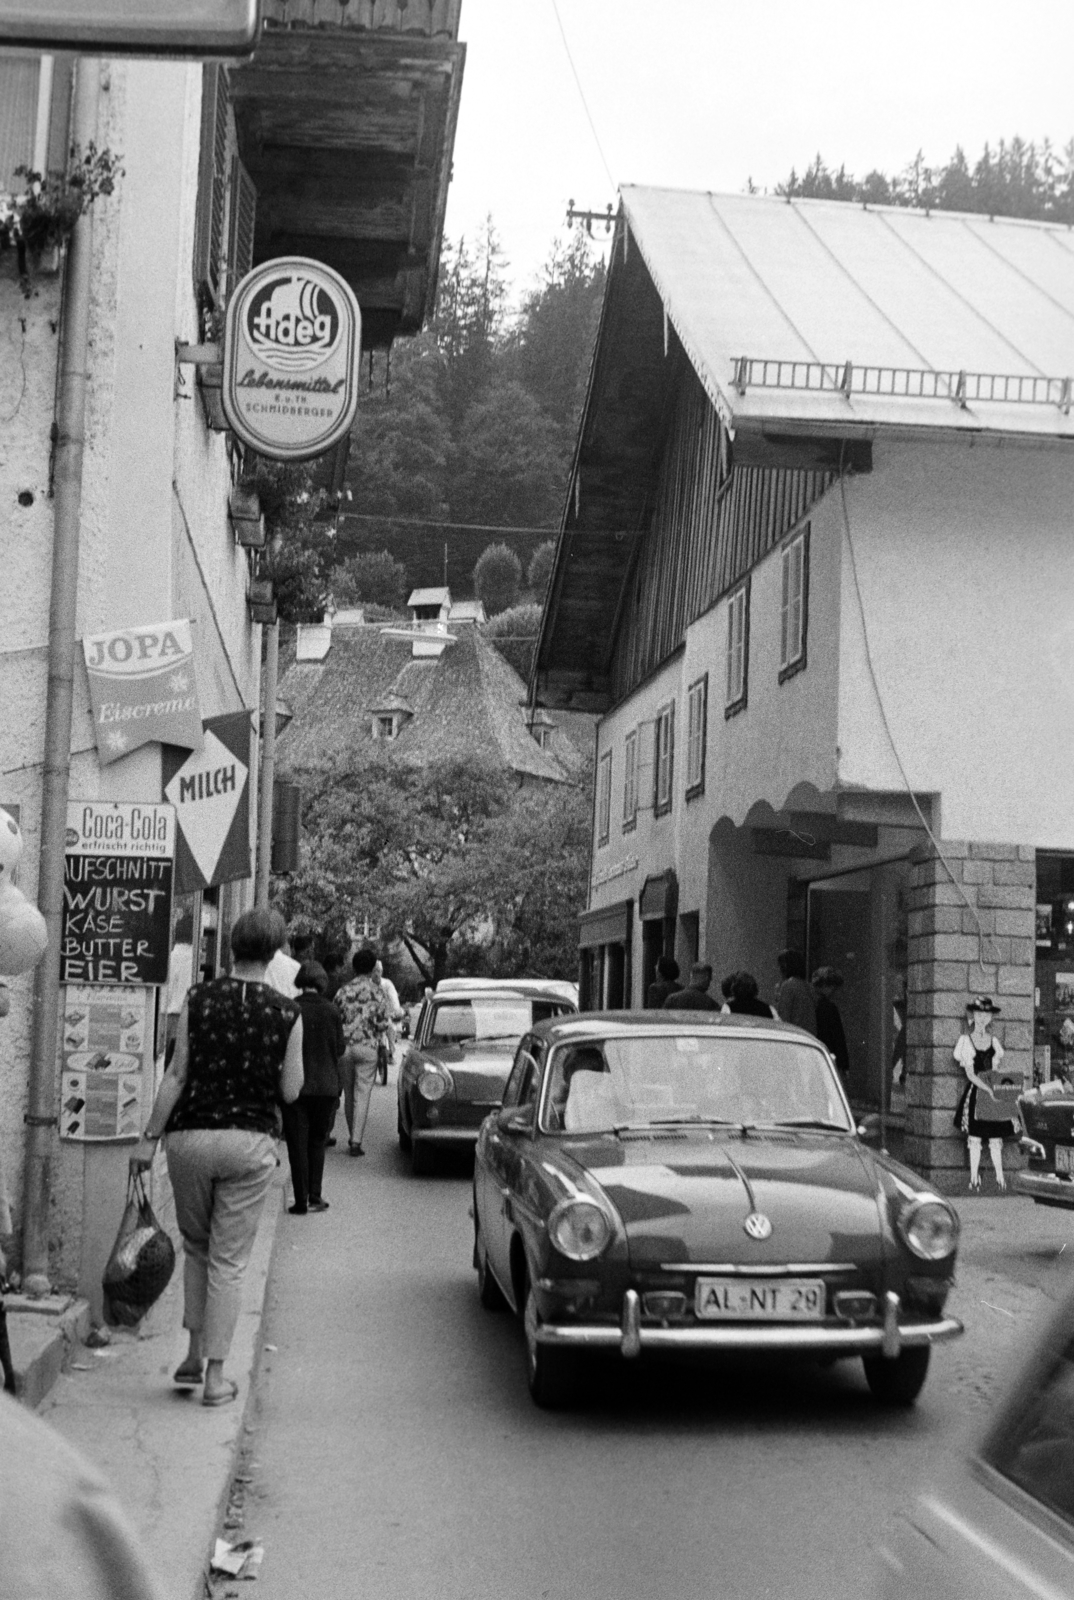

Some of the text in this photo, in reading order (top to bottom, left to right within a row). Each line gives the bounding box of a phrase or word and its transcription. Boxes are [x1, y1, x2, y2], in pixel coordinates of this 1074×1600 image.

[236, 369, 345, 394] Lebensmittel
[245, 402, 334, 418] SCHMIDBERGER
[89, 631, 185, 666] JOPA
[180, 764, 236, 803] MILCH
[81, 840, 167, 854] erfrischt richtig
[63, 884, 166, 915] WURST
[60, 937, 155, 957] BUTTER
[64, 957, 143, 982] EIER
